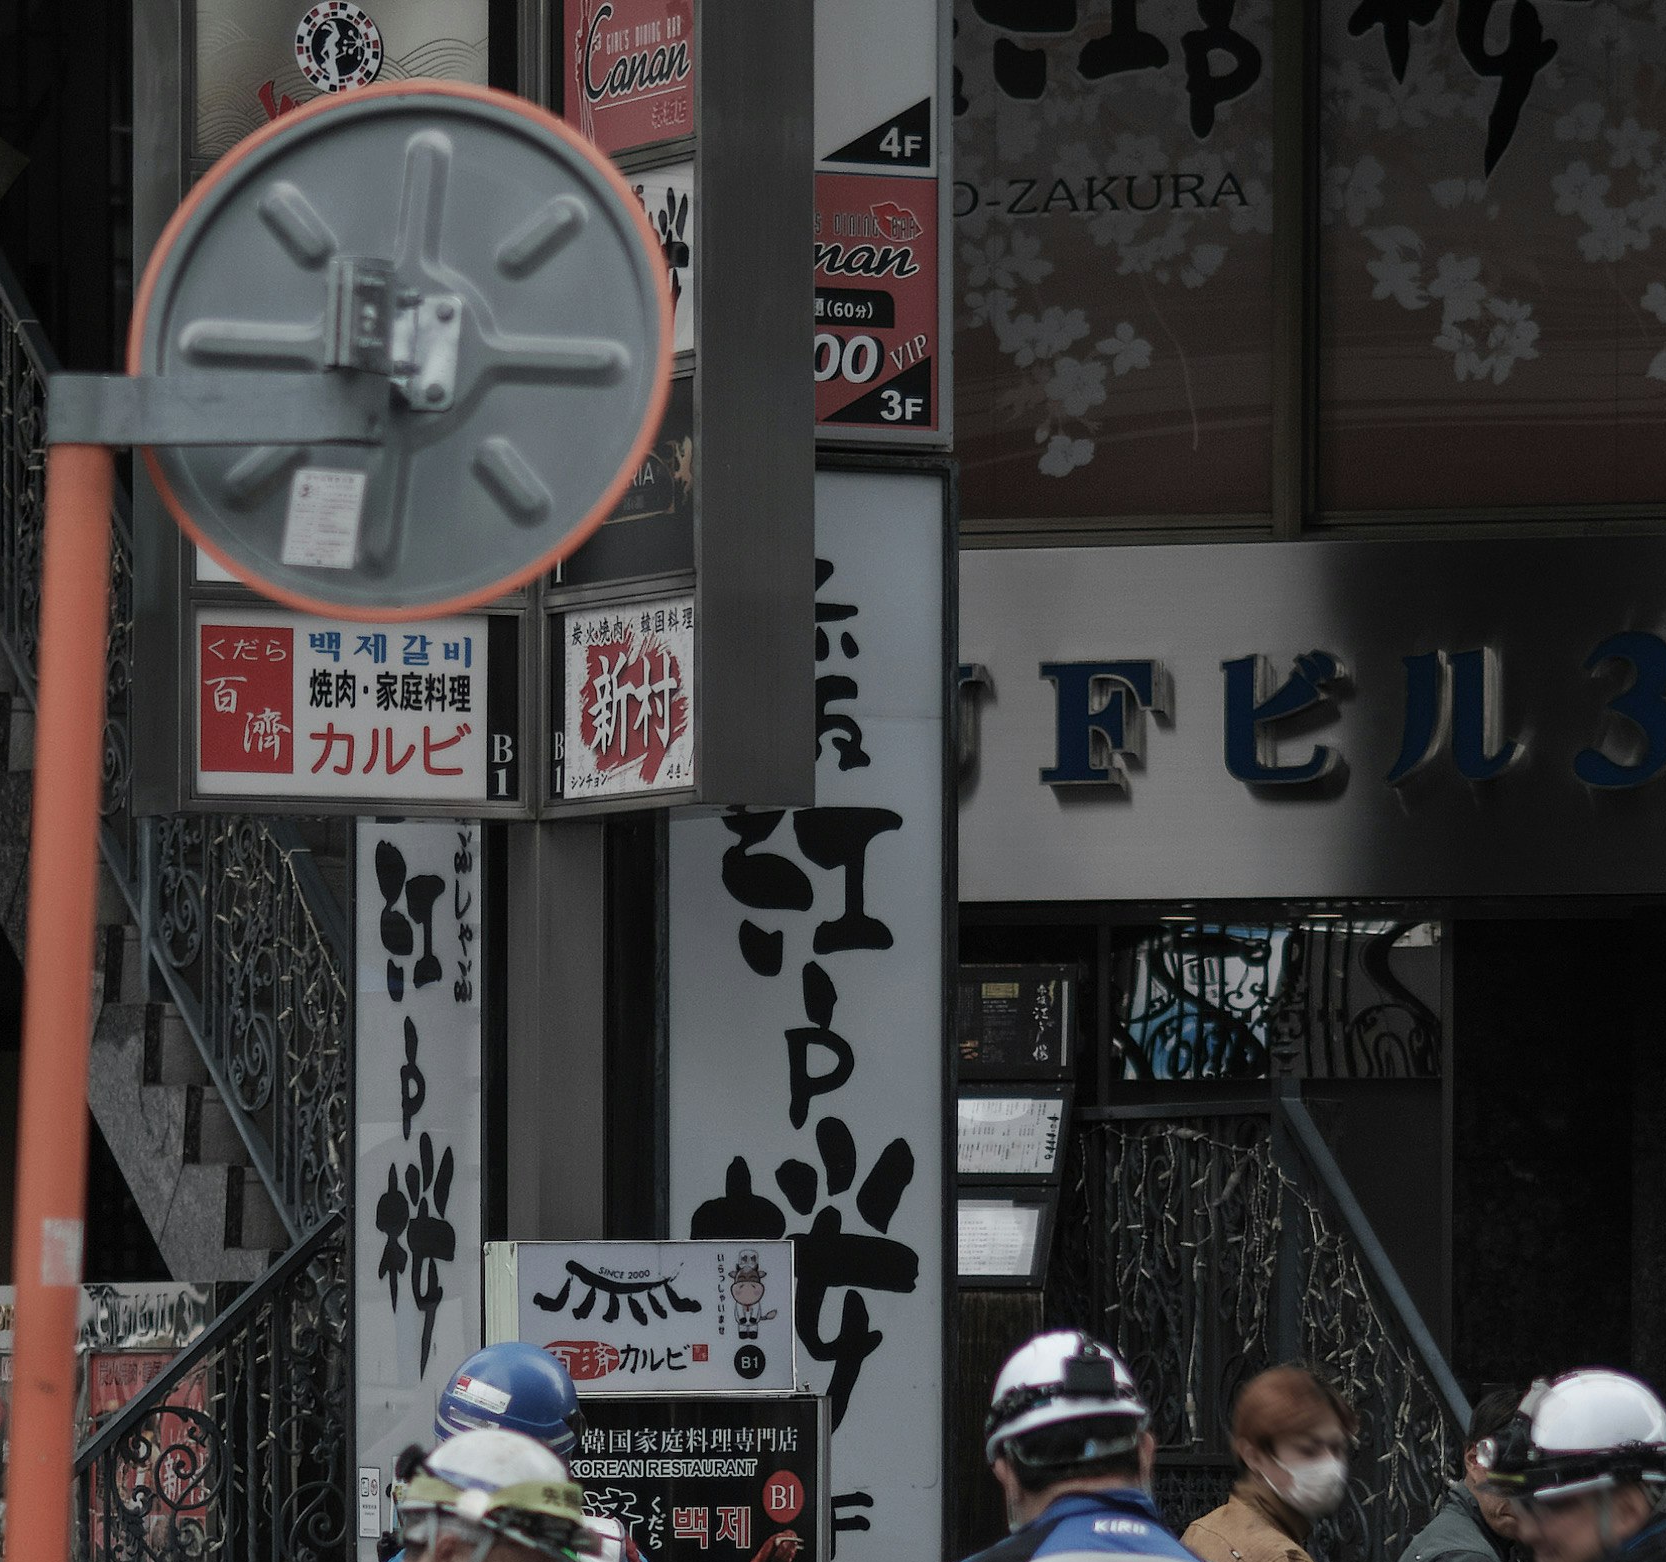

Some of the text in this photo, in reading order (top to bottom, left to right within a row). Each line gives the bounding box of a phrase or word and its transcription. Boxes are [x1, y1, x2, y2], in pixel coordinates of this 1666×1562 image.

[585, 4, 691, 102] Canan
[606, 13, 682, 56] GIRL'S DINING BAR
[879, 126, 923, 159] 4F
[953, 171, 1249, 218] O-ZAKURA
[814, 240, 920, 278] nan
[889, 333, 928, 371] VIP
[879, 389, 924, 421] 3F
[206, 636, 289, 665] くだら
[307, 631, 473, 668] 백제갈비
[308, 667, 473, 714] 焼肉・家庭料理
[587, 650, 680, 759] 新村
[309, 721, 473, 777] カルビ
[570, 771, 610, 791] シンチョン
[598, 1265, 651, 1280] SINCE 2000
[740, 1356, 761, 1370] B1
[579, 1426, 799, 1455] 韓国家庭料理専門店
[569, 1458, 759, 1479] KOREAN RESTAURANT
[769, 1483, 796, 1511] B1
[648, 1494, 665, 1551] くだら
[672, 1505, 752, 1551] 백제
